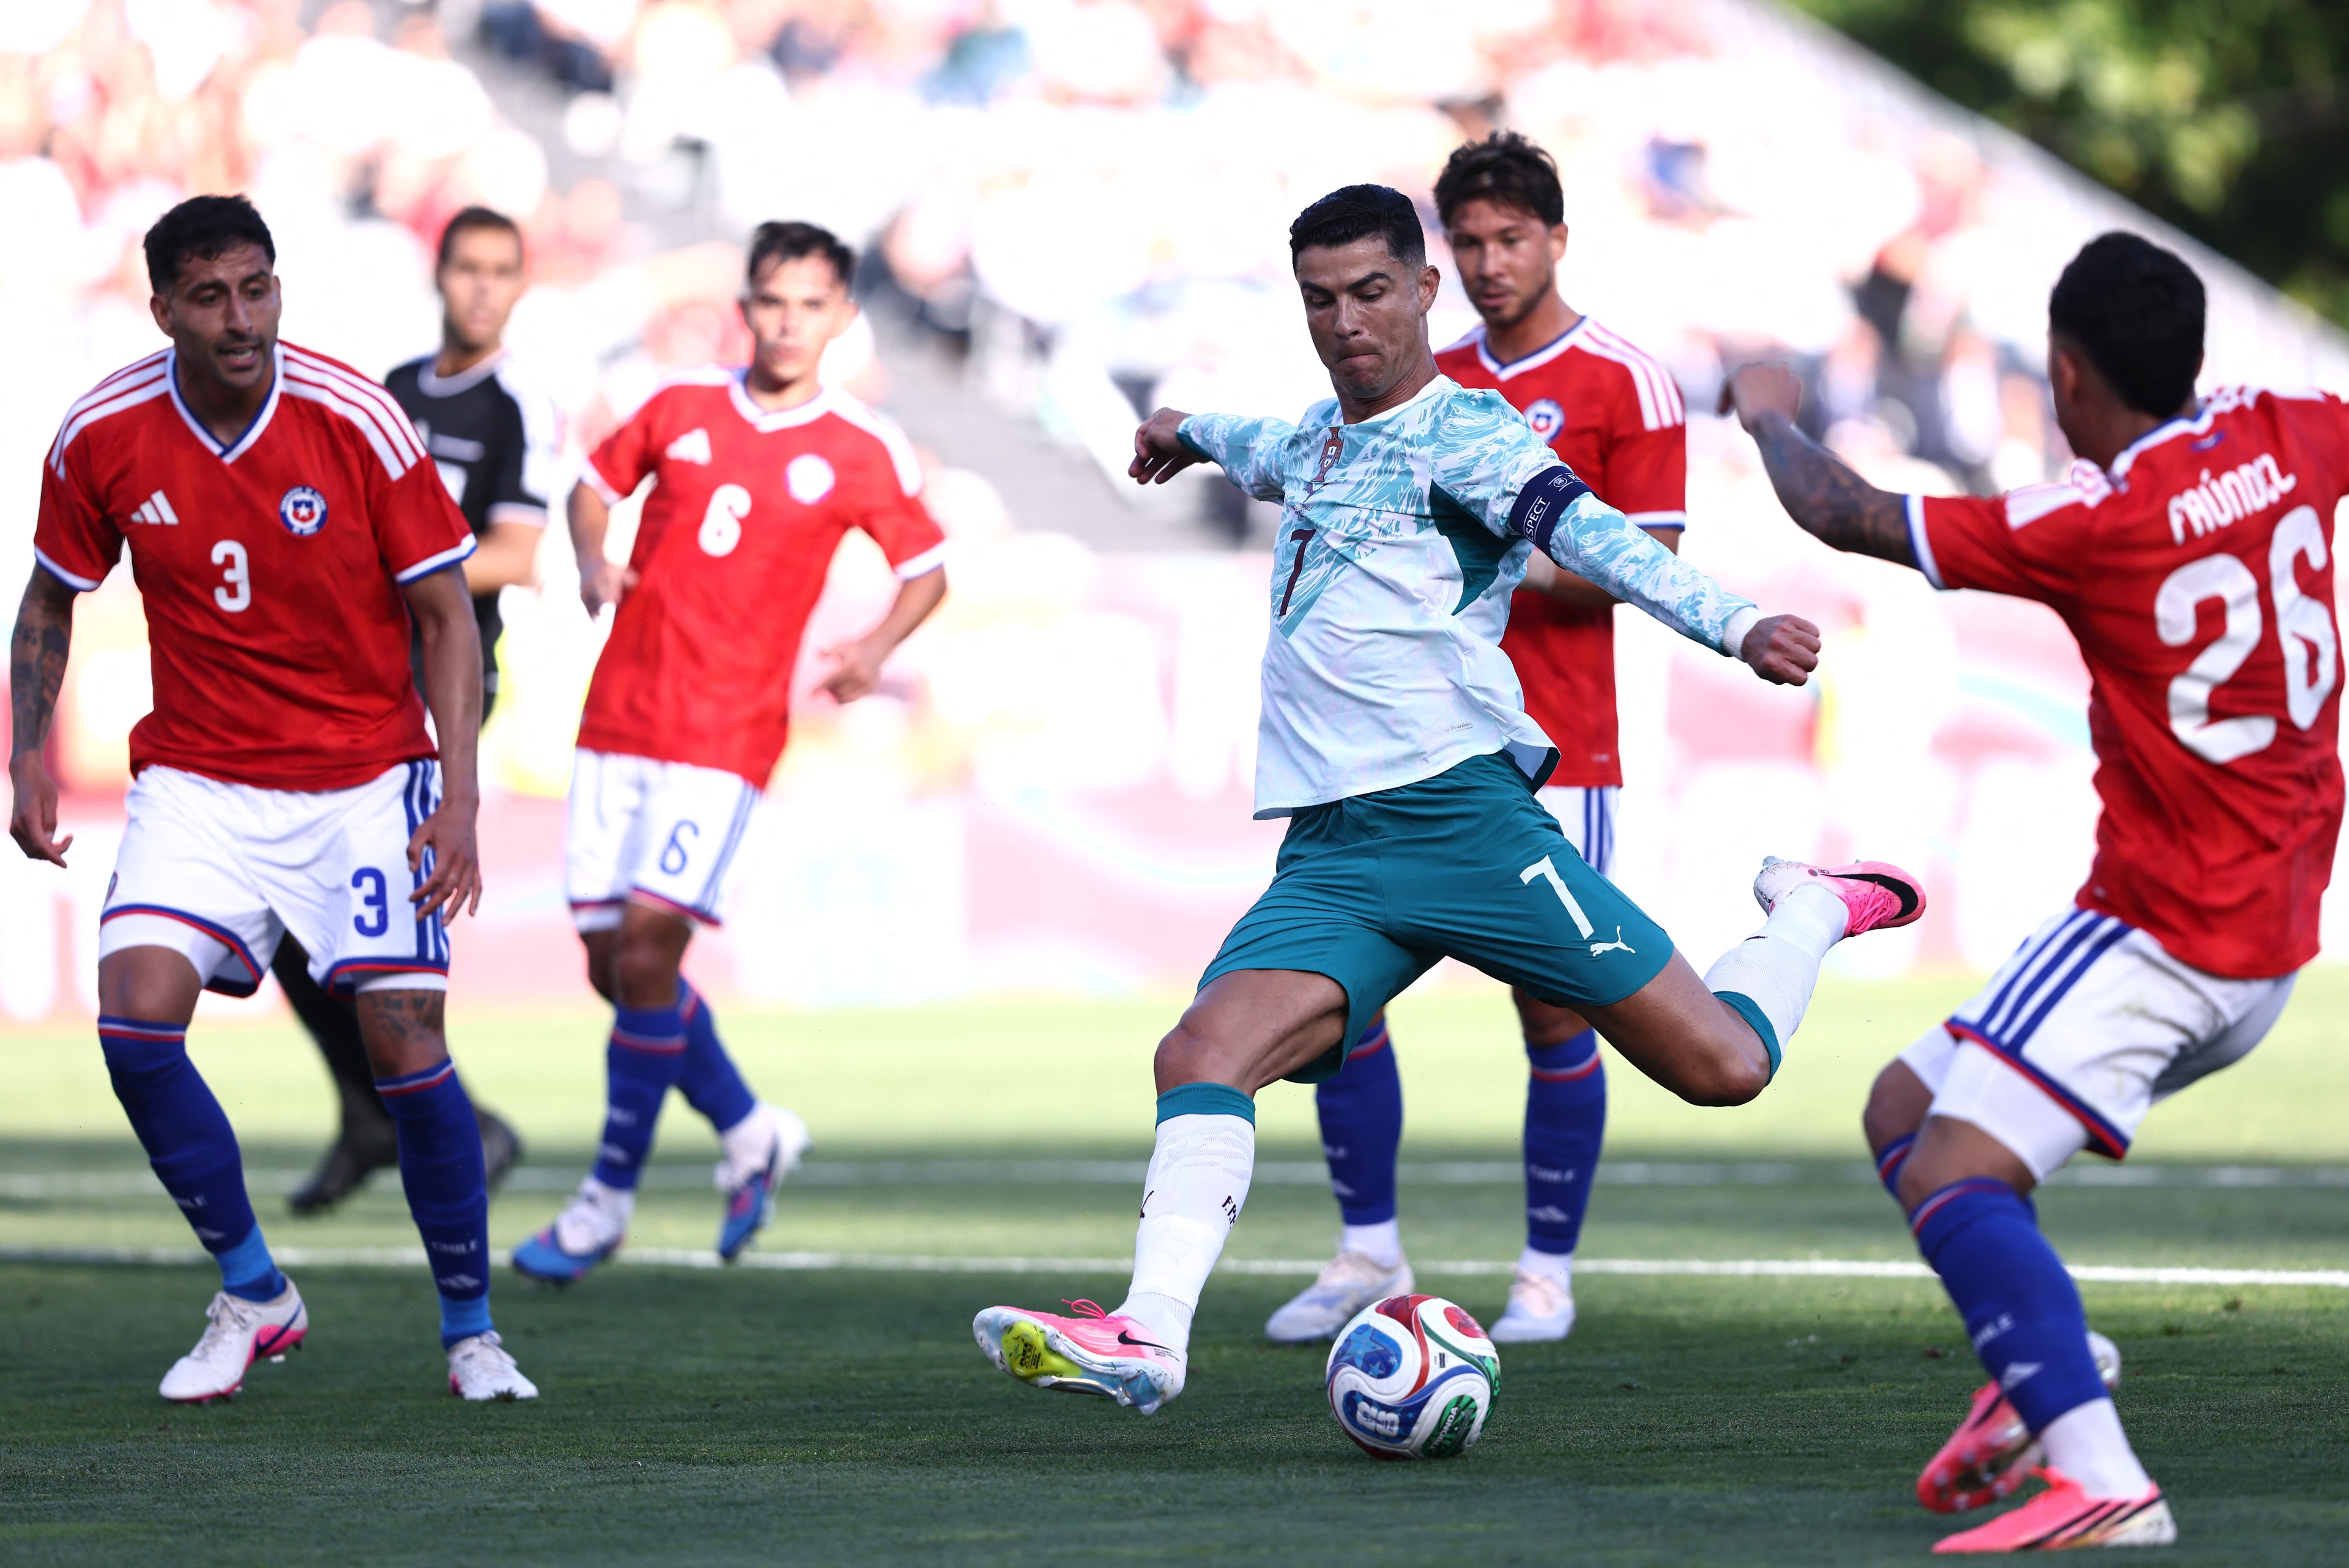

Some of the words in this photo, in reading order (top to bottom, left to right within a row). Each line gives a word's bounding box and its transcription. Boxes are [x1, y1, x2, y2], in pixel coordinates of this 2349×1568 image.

[697, 483, 752, 557] 6
[1526, 497, 1546, 543] ESPECT
[2168, 452, 2297, 546] FAÚNDZ
[210, 539, 251, 613] 3
[1279, 529, 1316, 617] 7
[2154, 504, 2336, 765] 26
[660, 819, 699, 875] 6
[351, 867, 389, 937] 3
[1519, 855, 1594, 940] 7
[1019, 1342, 1028, 1367] AIR
[1024, 1343, 1034, 1369] ZOOM
[1428, 1406, 1458, 1449] TRIONDA
